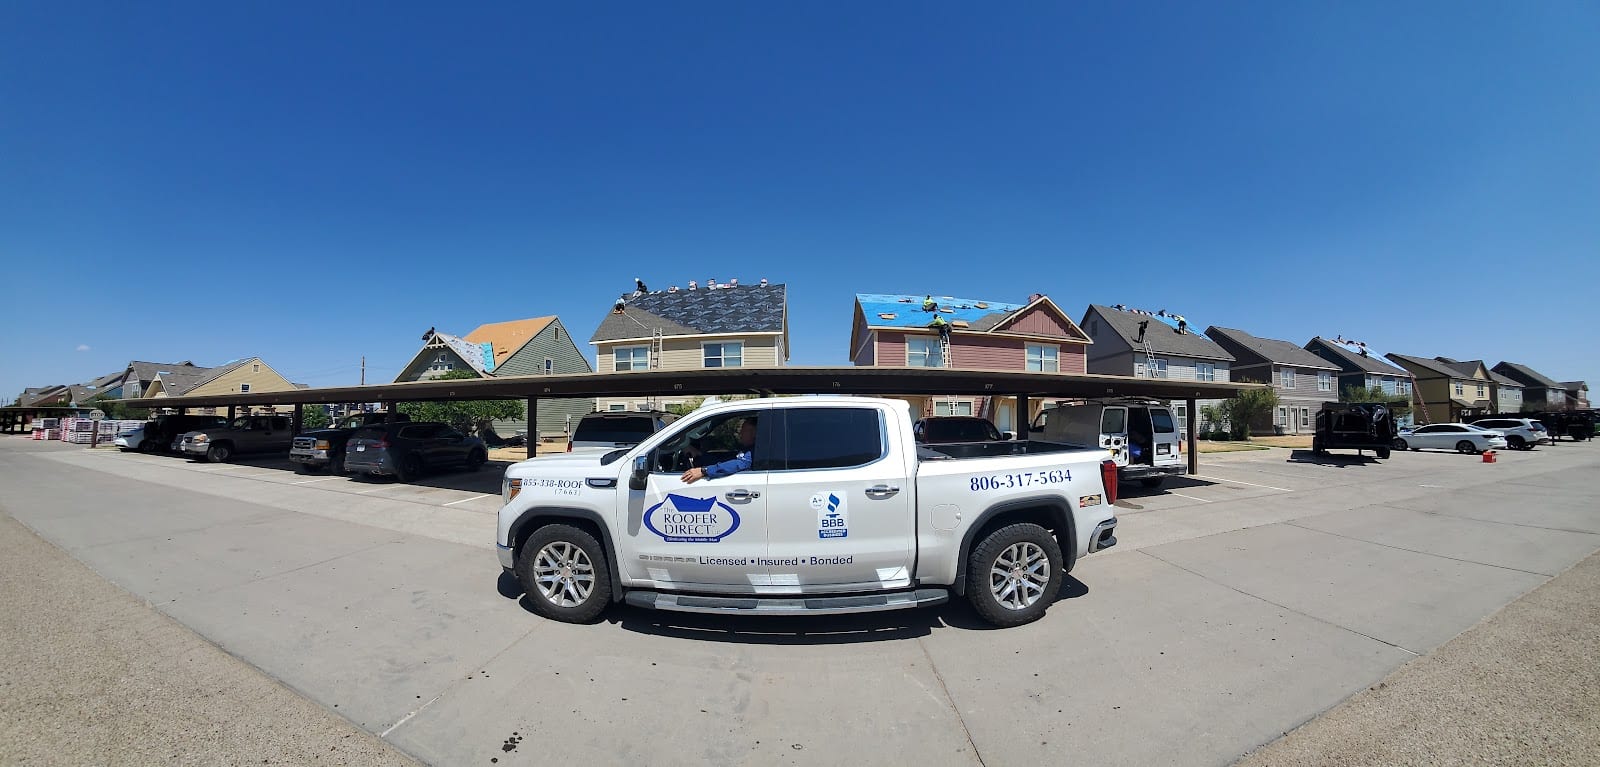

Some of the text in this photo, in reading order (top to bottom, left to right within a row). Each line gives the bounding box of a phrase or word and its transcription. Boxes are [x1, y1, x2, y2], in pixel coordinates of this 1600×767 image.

[524, 478, 584, 488] 855-338-ROOF
[970, 469, 1072, 491] 806-317-5634
[664, 514, 717, 524] ROOFER
[822, 518, 844, 528] BBB
[664, 525, 710, 535] DIRECT
[699, 556, 746, 566] Licensed
[758, 556, 798, 566] Insured
[811, 556, 853, 566] Bonded
